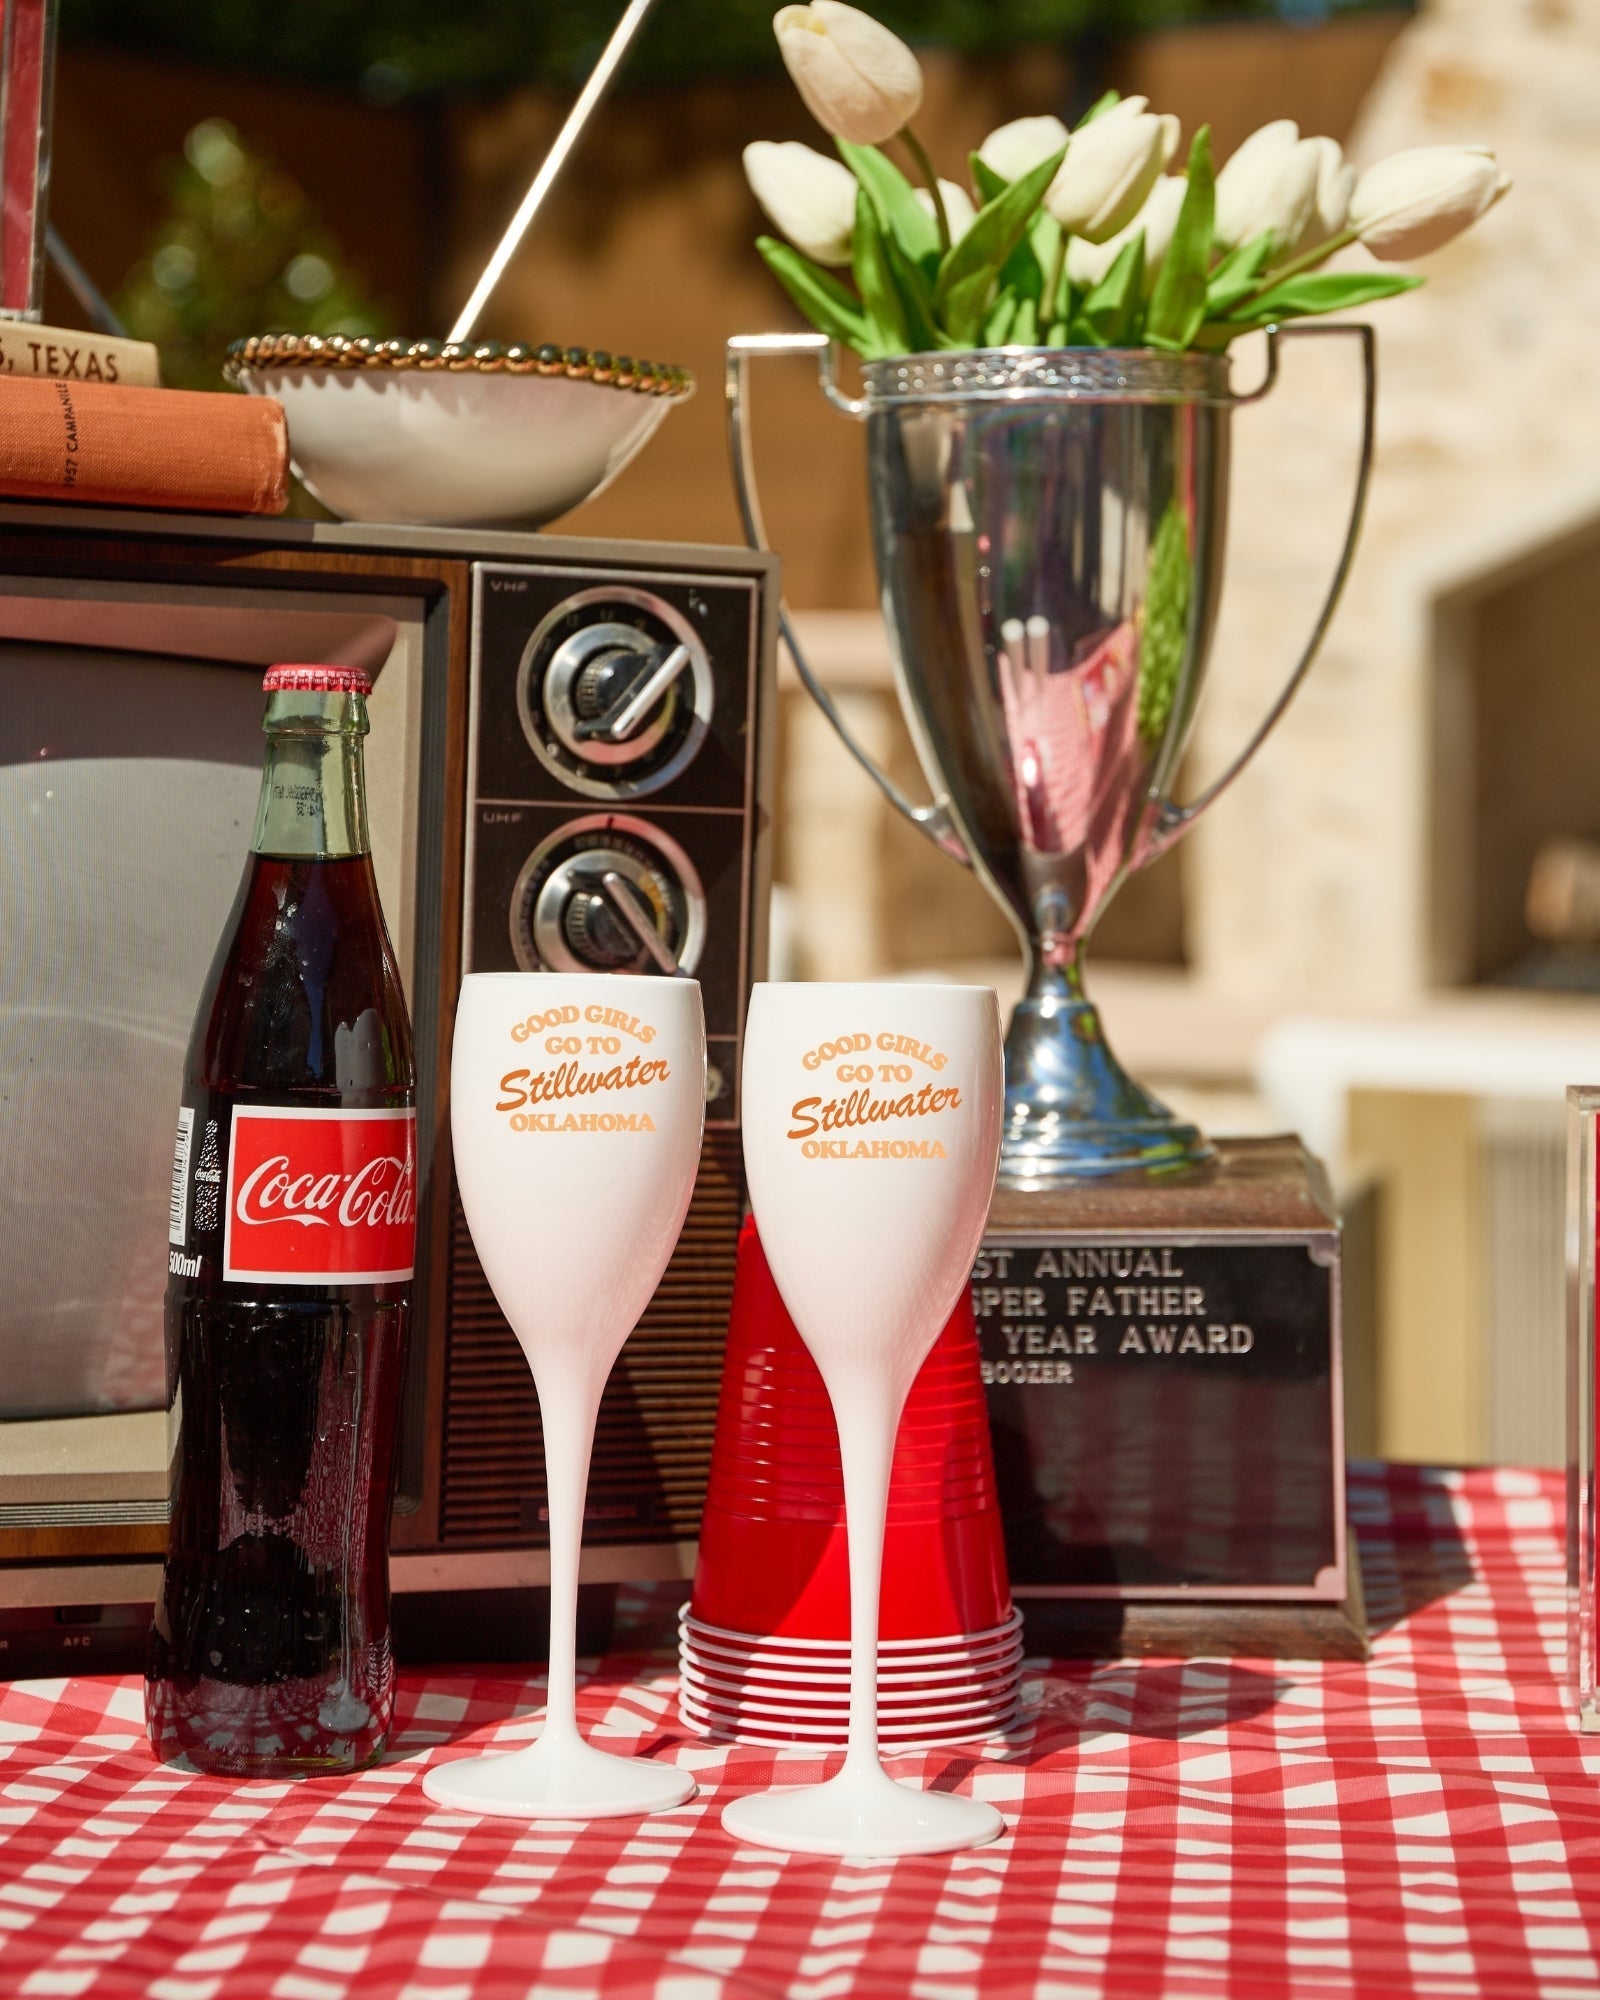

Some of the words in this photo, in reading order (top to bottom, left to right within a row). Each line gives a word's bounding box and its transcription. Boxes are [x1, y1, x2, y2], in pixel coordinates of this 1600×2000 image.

[27, 341, 118, 382] TEXAS
[56, 383, 78, 452] CAMPANILE
[490, 580, 528, 592] VHF
[483, 812, 523, 824] UHF
[510, 1005, 580, 1043] GOOD
[584, 1004, 657, 1044] GIRLS
[544, 1036, 583, 1055] GO
[586, 1036, 621, 1055] TO
[802, 1033, 872, 1071] GOOD
[876, 1032, 948, 1072] GIRLS
[495, 1055, 671, 1112] Stillwater
[836, 1064, 874, 1083] GO
[878, 1064, 913, 1083] TO
[509, 1113, 657, 1133] OKLAHOMA
[787, 1083, 962, 1139] Stillwater
[801, 1140, 948, 1159] OKLAHOMA
[236, 1155, 413, 1227] Coca-Cola
[168, 1251, 203, 1278] 500ml
[1034, 1249, 1184, 1278] ANNUAL
[1066, 1286, 1207, 1316] FATHER
[1001, 1325, 1098, 1354] YEAR
[1119, 1324, 1254, 1354] AWARD
[980, 1360, 1074, 1384] BOOZER
[63, 1636, 91, 1647] AFC
